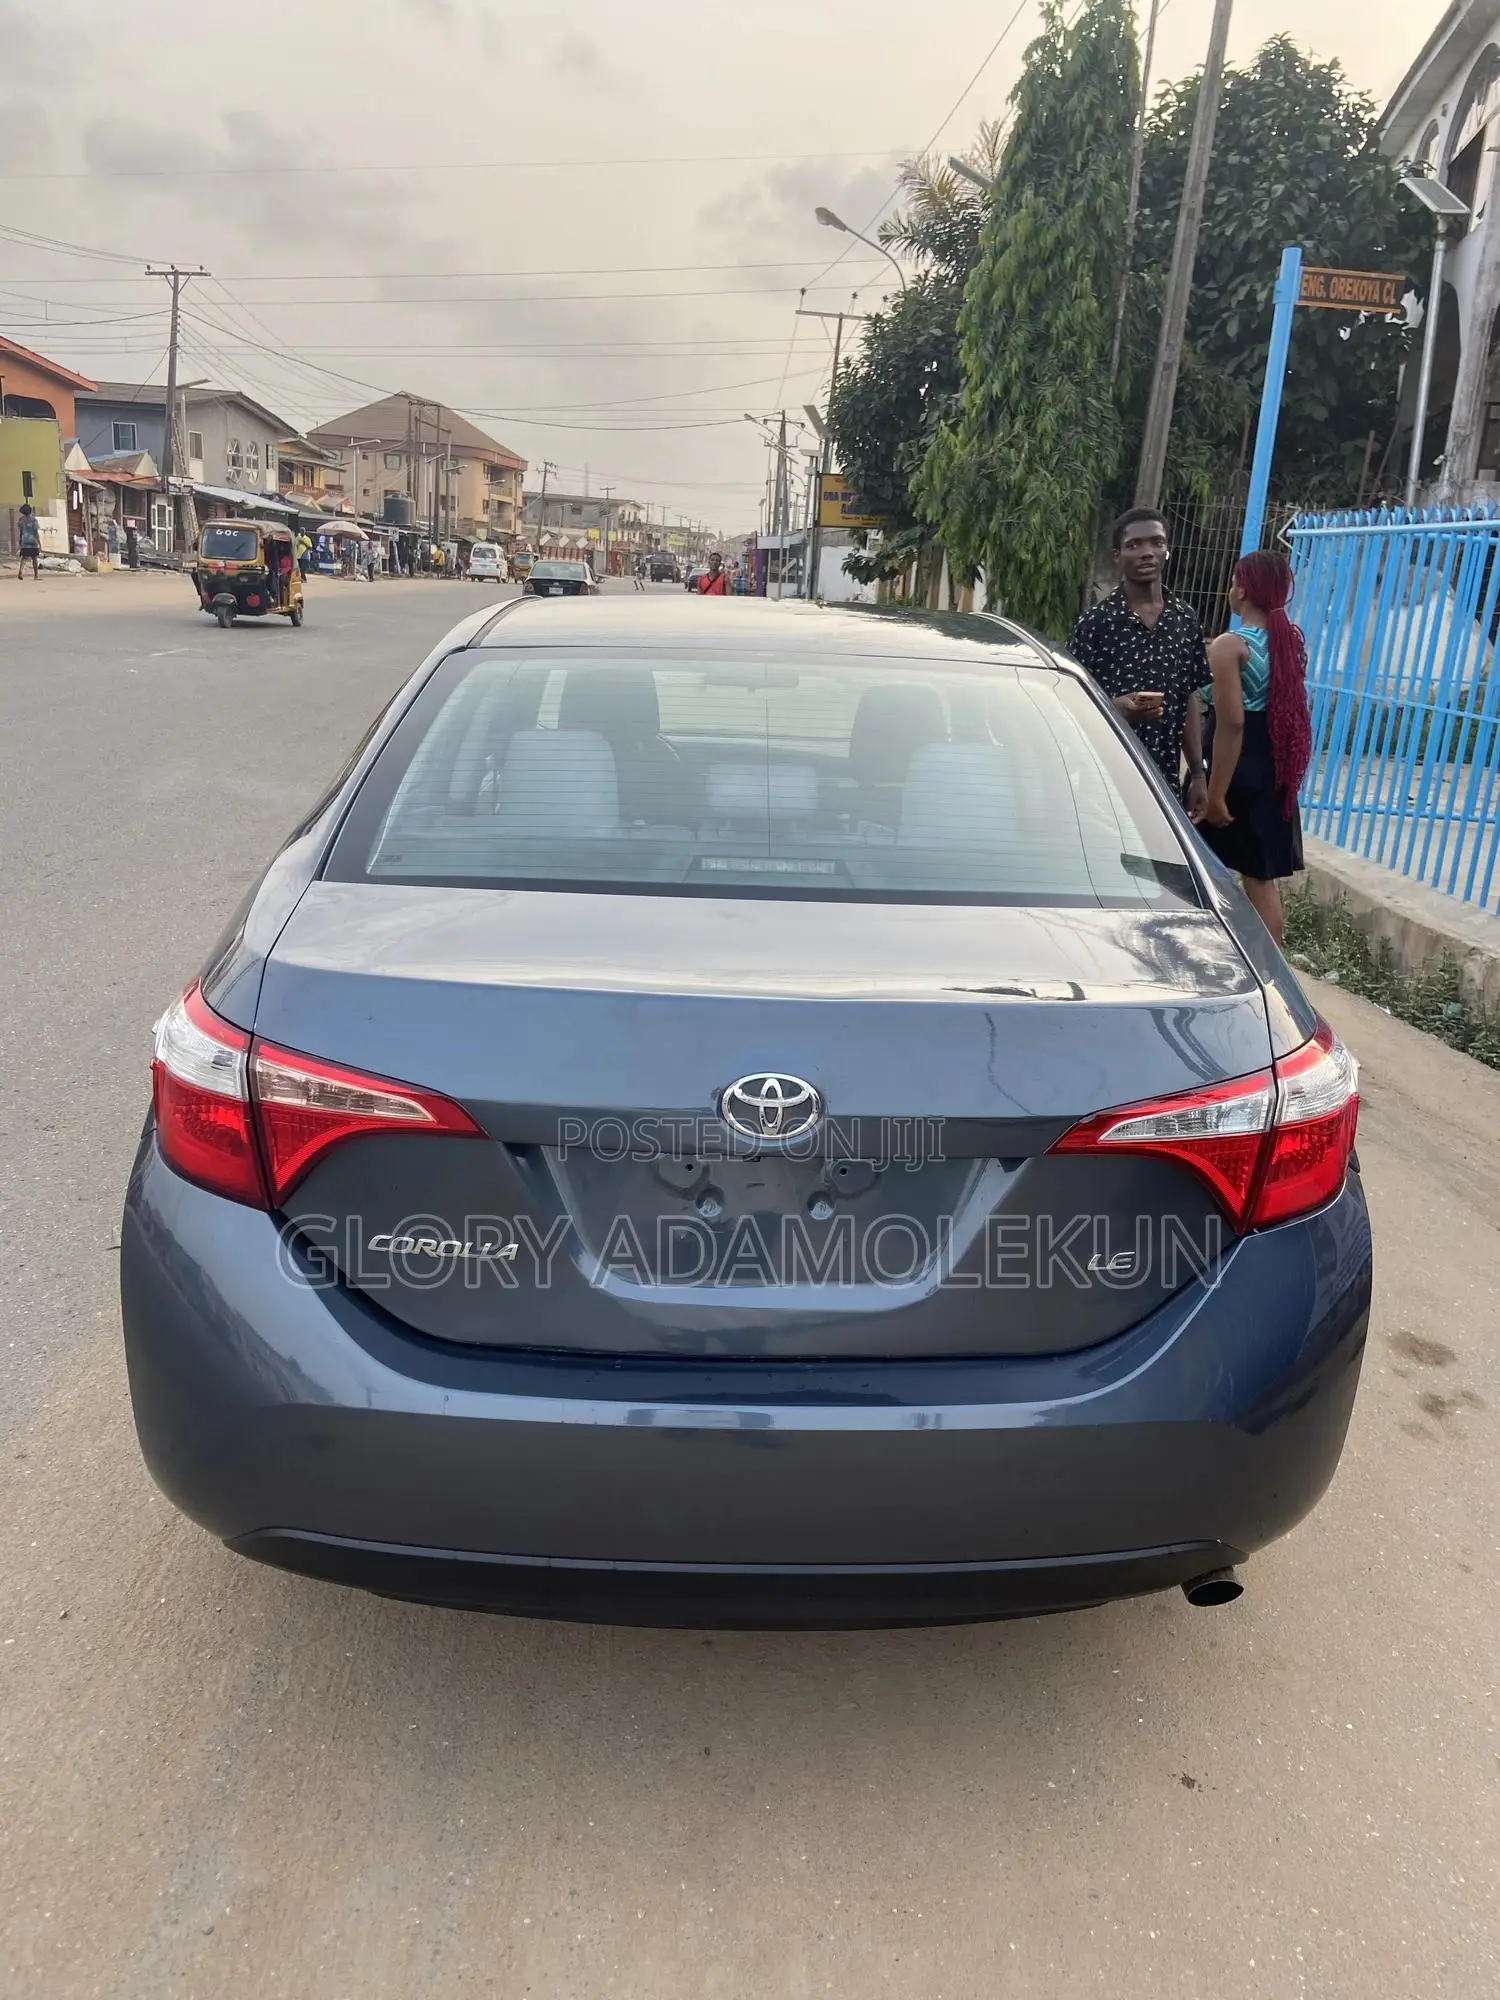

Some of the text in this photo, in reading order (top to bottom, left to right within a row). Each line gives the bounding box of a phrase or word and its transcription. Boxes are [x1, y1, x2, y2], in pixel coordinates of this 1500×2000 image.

[1302, 275, 1396, 304] ENG. OREKOYA CL
[367, 1234, 519, 1261] COROLLA
[1088, 1252, 1135, 1270] LE
